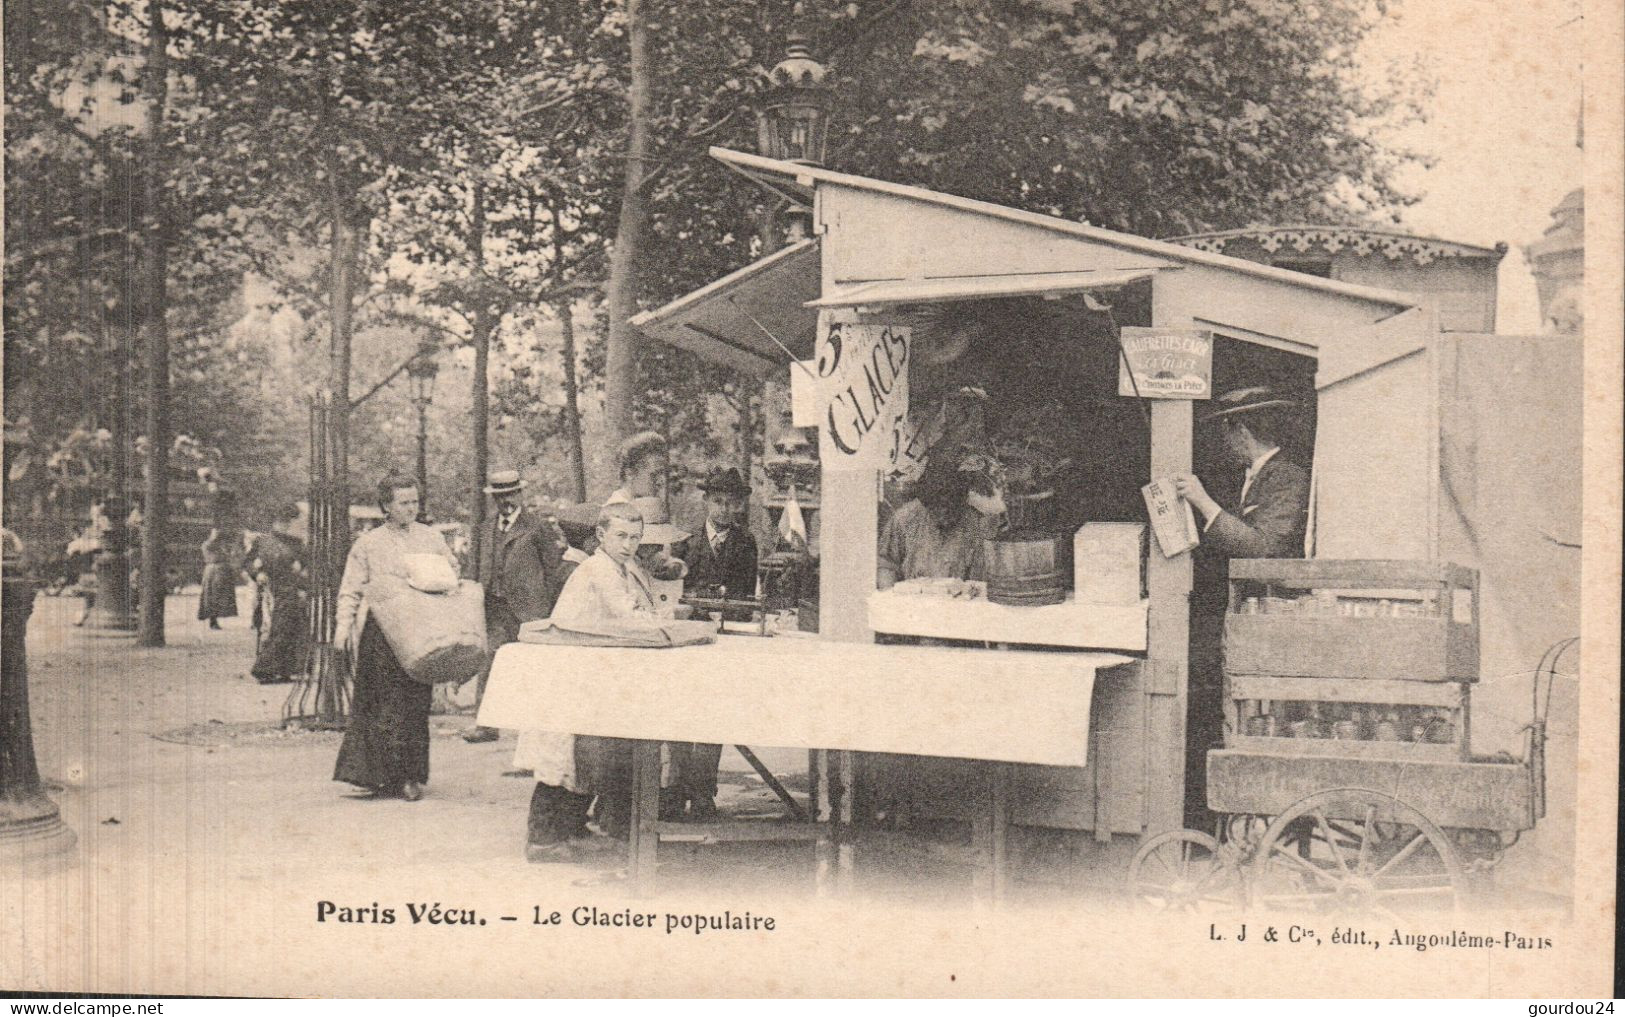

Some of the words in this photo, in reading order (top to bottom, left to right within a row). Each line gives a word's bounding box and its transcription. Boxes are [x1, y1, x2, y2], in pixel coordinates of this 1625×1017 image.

[818, 321, 842, 378] 5
[828, 327, 907, 456] GLACES
[317, 900, 396, 925] Paris
[406, 902, 487, 926] Vécu.
[533, 905, 561, 925] Le
[572, 906, 657, 928] Glacier
[665, 911, 775, 935] populaire
[1264, 926, 1279, 943] &
